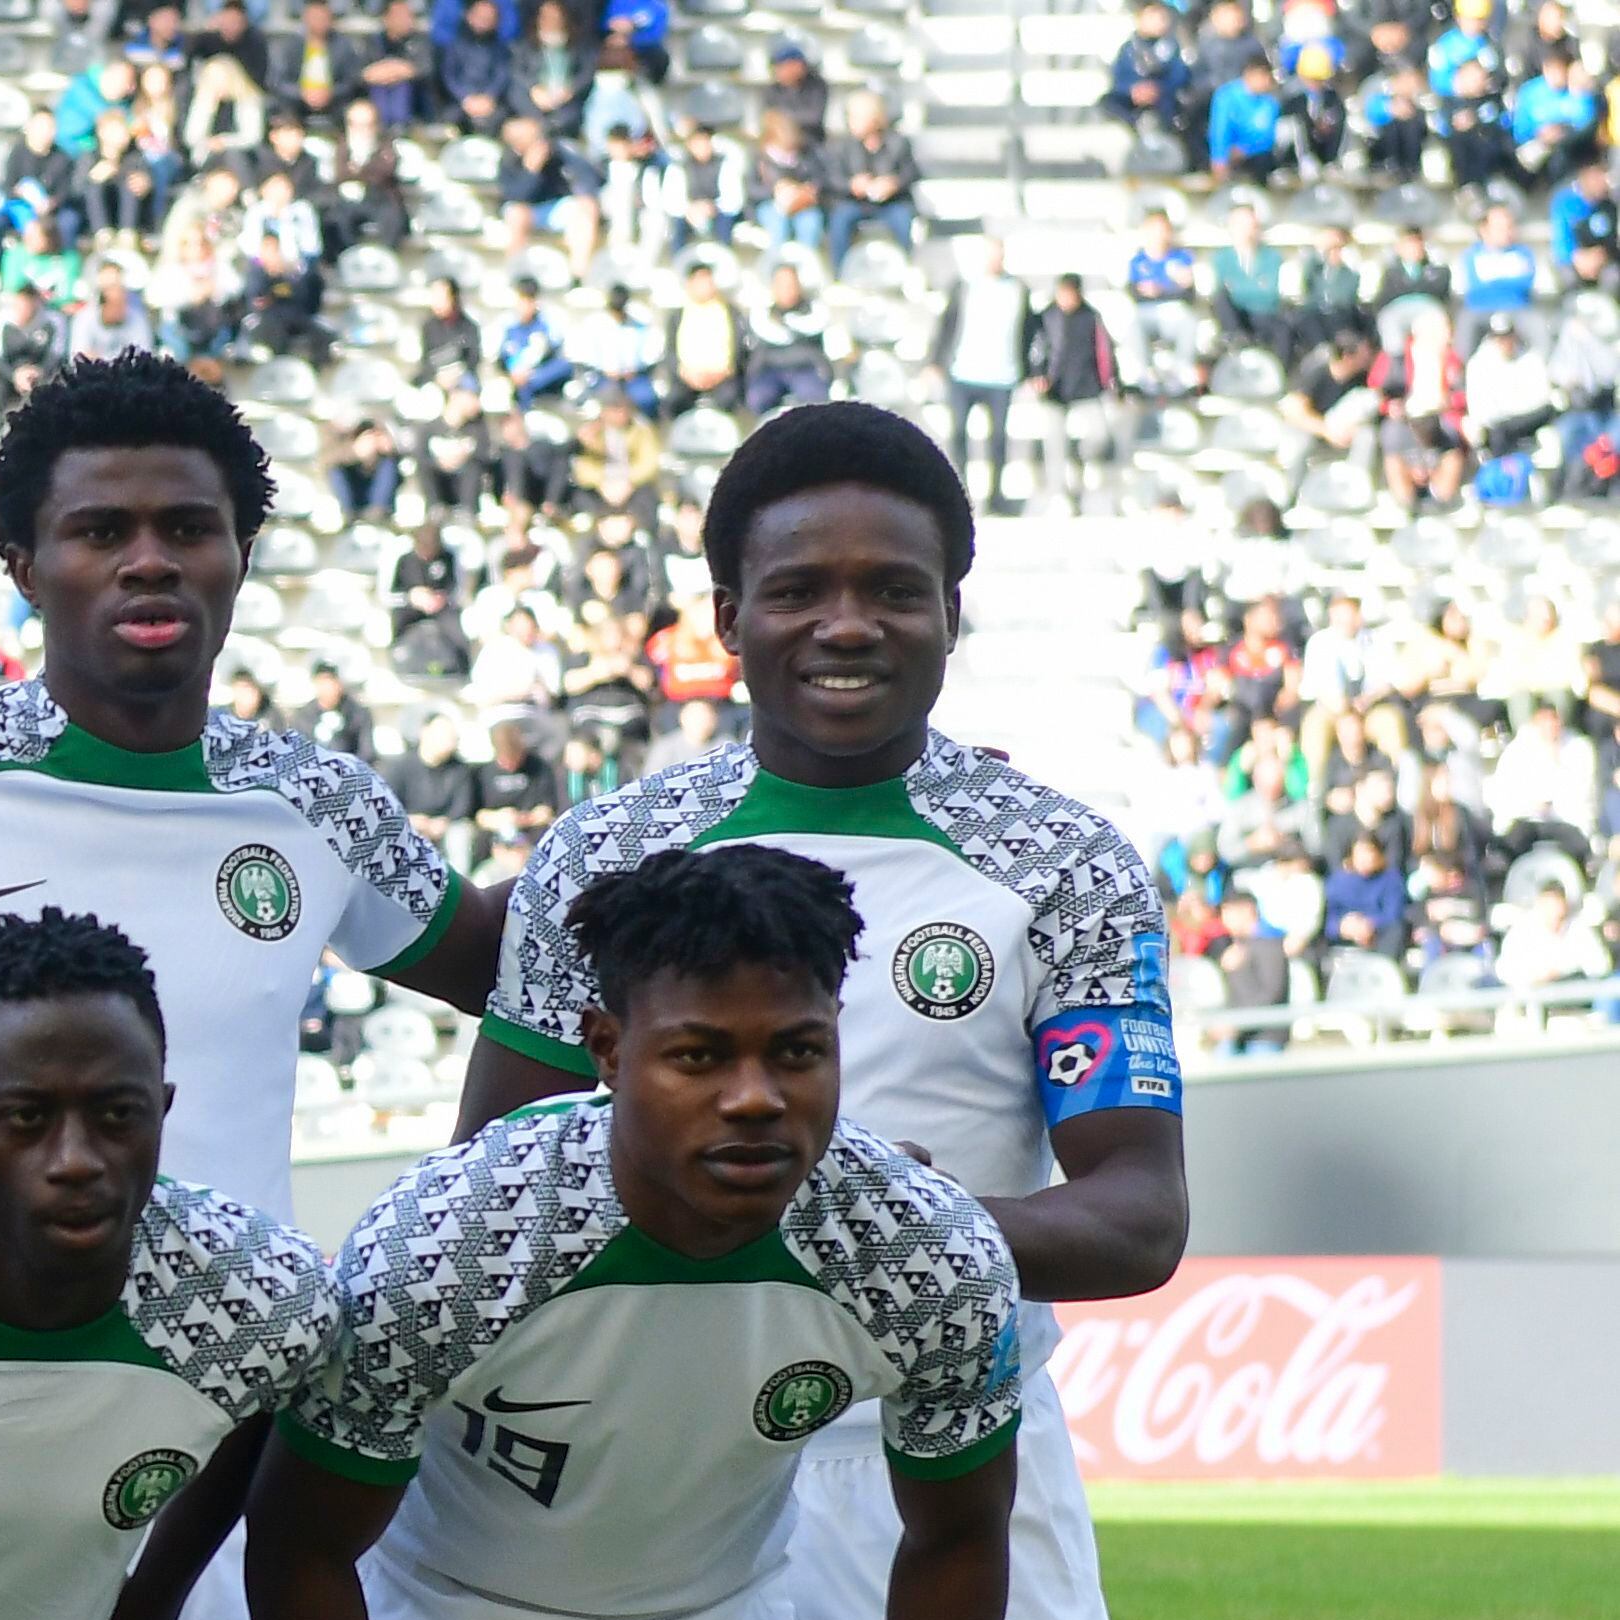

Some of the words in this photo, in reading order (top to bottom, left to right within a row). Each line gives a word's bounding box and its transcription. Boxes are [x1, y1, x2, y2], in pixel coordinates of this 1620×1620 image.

[220, 846, 269, 880] FOOTBALL
[218, 881, 246, 928] NIGERIA
[269, 852, 300, 924] FEDERATION
[901, 925, 964, 953] FOOTBALL
[894, 953, 918, 1001] NIGERIA
[963, 932, 993, 1005] FEDERATION
[929, 1005, 958, 1017] 1945
[1121, 1018, 1170, 1040] FOOTB
[1123, 1033, 1177, 1060] UNITE
[1137, 1080, 1165, 1093] FIFA
[1049, 1273, 1422, 1464] a-Cola
[452, 1400, 571, 1508] 19
